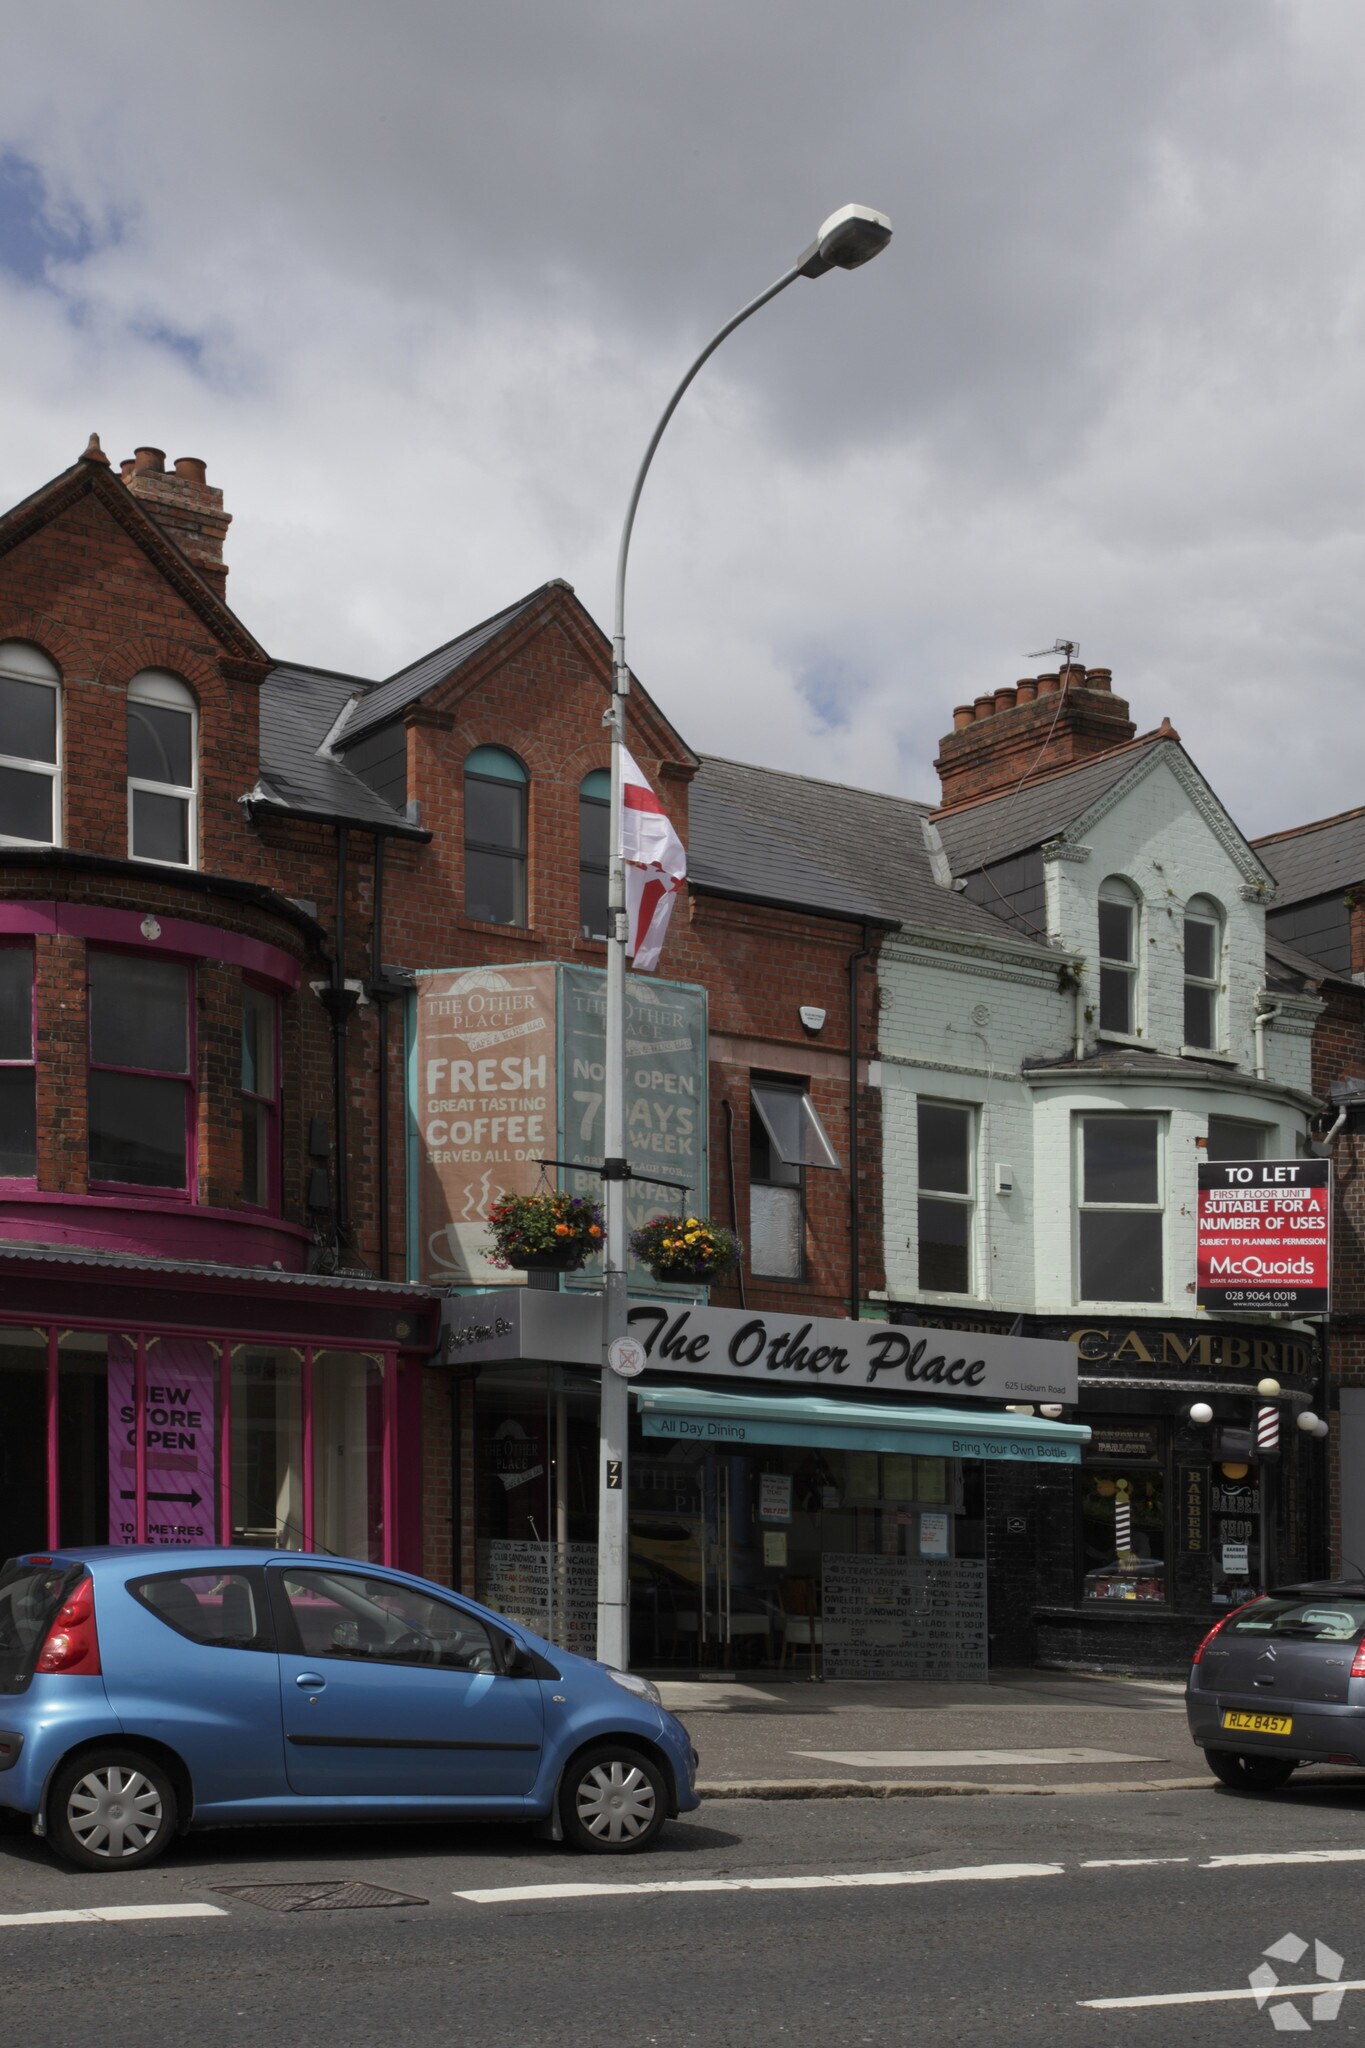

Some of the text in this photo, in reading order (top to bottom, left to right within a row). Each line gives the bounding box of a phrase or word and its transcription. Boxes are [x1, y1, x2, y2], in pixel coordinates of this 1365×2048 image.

[427, 994, 536, 1015] THE OTHER
[454, 1012, 514, 1029] PLACE
[502, 1025, 525, 1039] WINE
[526, 1019, 544, 1031] BAR
[427, 1055, 547, 1094] FRESH
[634, 1069, 694, 1096] OPEN
[427, 1096, 547, 1113] GREAT TASTING
[572, 1090, 694, 1141] 7 AYS
[426, 1115, 545, 1146] COFFEE
[628, 1129, 693, 1156] WEEK
[426, 1148, 545, 1163] SERVED ALL DAY
[1225, 1166, 1300, 1183] TO LET
[1213, 1189, 1307, 1199] FIRST FLOOR UNIT
[1204, 1199, 1320, 1213] SUITABLE FOR A
[1200, 1216, 1326, 1230] NUMBER OF USES
[1199, 1237, 1327, 1246] SUBJECT TO PLANNING PERMISSION
[1210, 1256, 1315, 1277] McQuoids
[1225, 1291, 1297, 1301] 028 9064 0018
[627, 1305, 710, 1371] The
[728, 1318, 851, 1383] Other
[866, 1331, 987, 1394] Place
[1005, 1381, 1066, 1394] 625 Lisburn Road
[120, 1406, 202, 1428] SORE
[660, 1420, 746, 1440] All Day Dining
[952, 1441, 1067, 1458] Bring Your Own Bottle
[1212, 1486, 1260, 1514] BARBER
[1187, 1471, 1201, 1550] BARBERS
[148, 1524, 204, 1536] METRES
[1220, 1520, 1252, 1545] SHOP
[494, 1553, 508, 1561] CLUB
[508, 1554, 537, 1564] SANDWICH
[518, 1585, 549, 1596] ESPRESSO
[506, 1605, 521, 1615] CLUB
[840, 1606, 863, 1615] CLUB
[864, 1608, 908, 1617] SANDWICH
[1229, 1713, 1287, 1731] RLZ 8457
